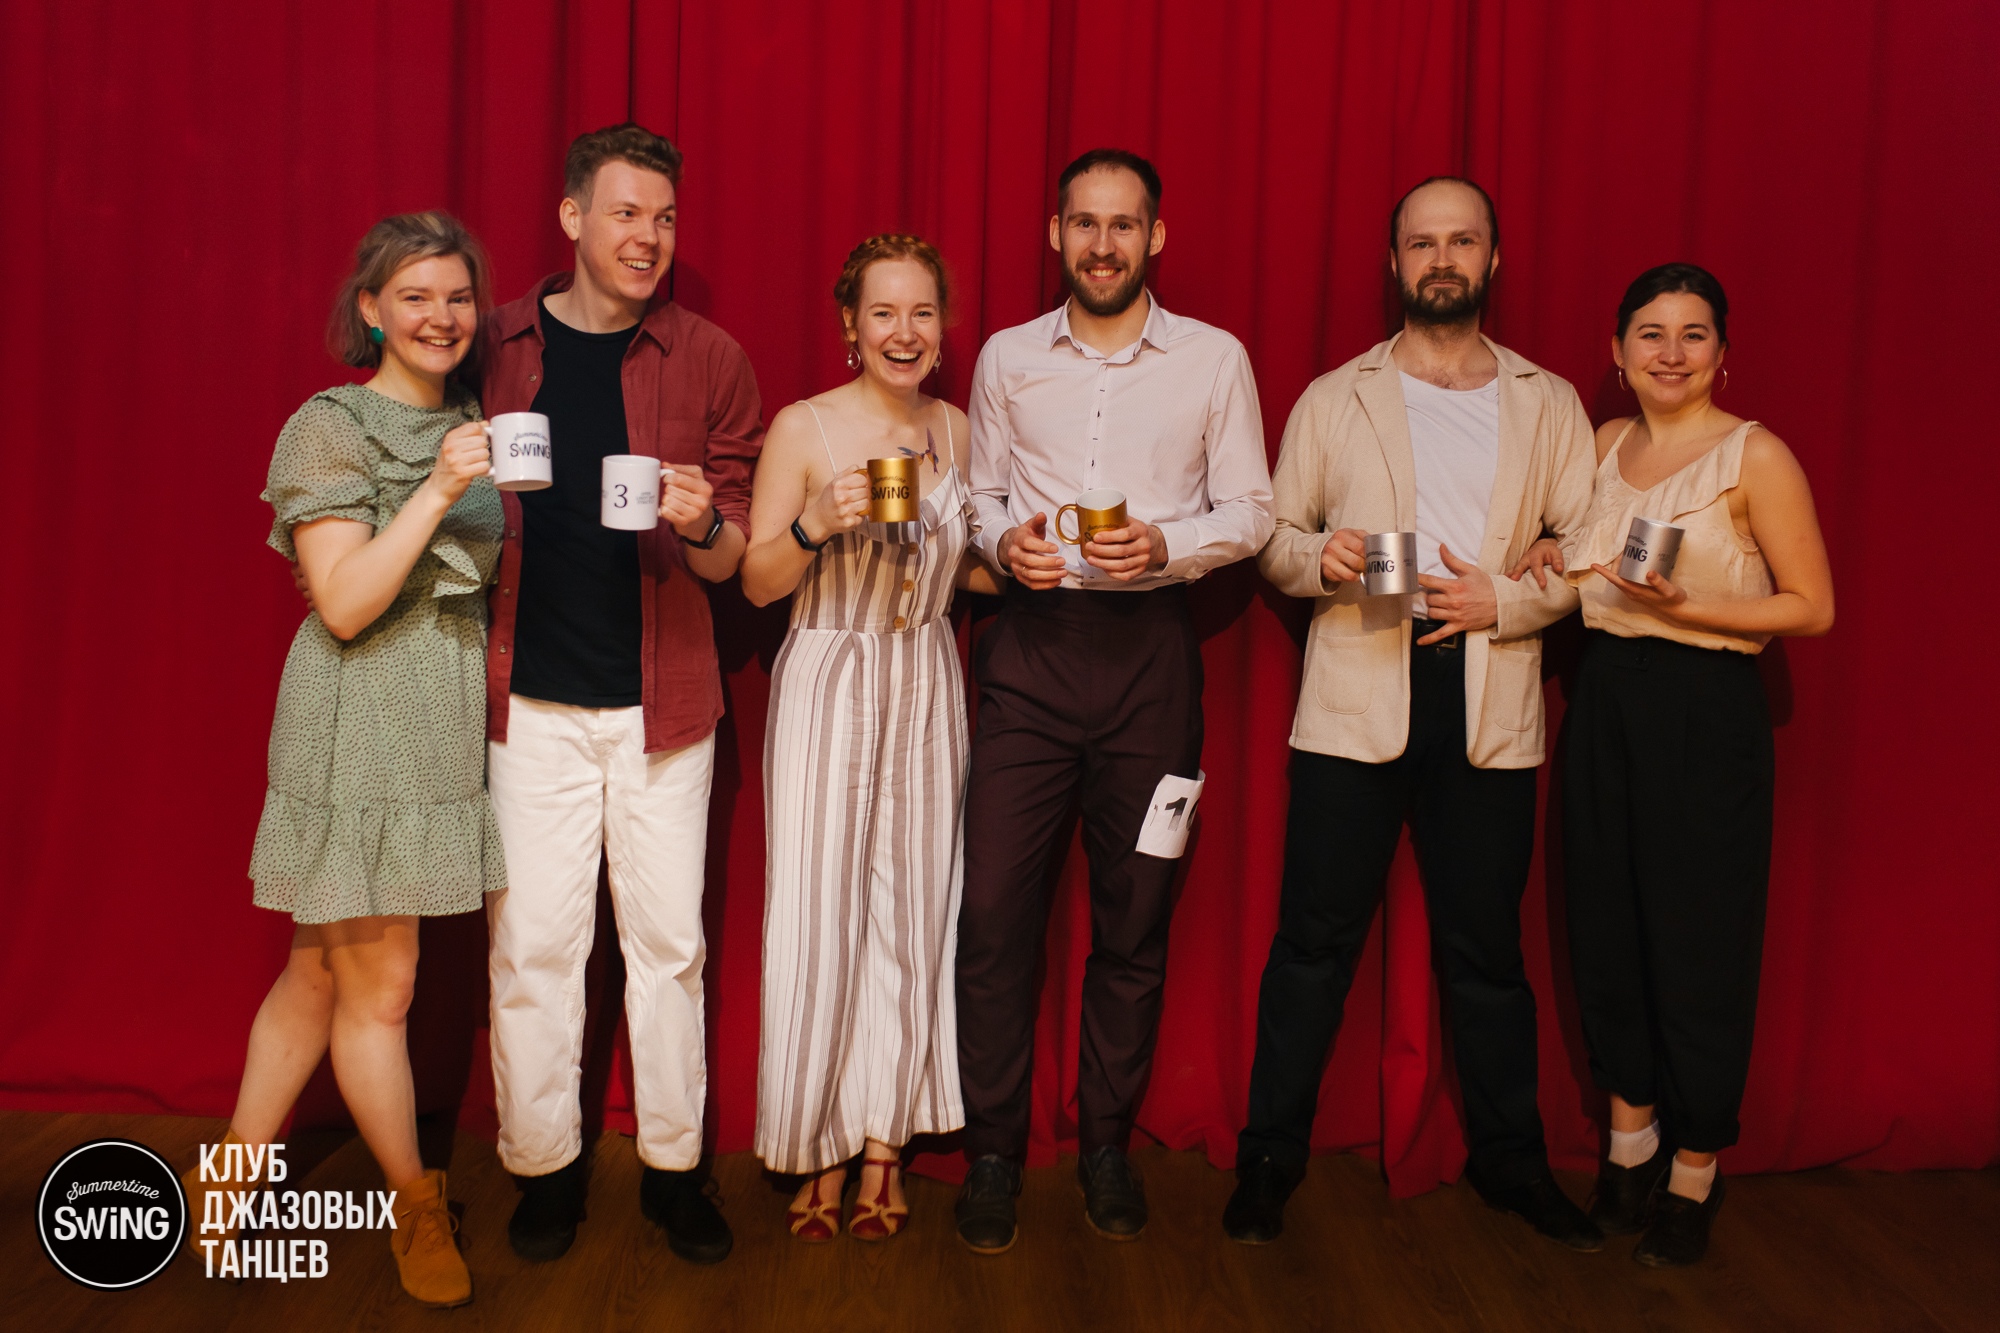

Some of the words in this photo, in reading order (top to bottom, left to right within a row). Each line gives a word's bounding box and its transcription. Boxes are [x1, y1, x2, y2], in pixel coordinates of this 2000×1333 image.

[614, 483, 628, 508] 3
[871, 486, 910, 500] SWiNG
[1366, 559, 1395, 574] WiNG
